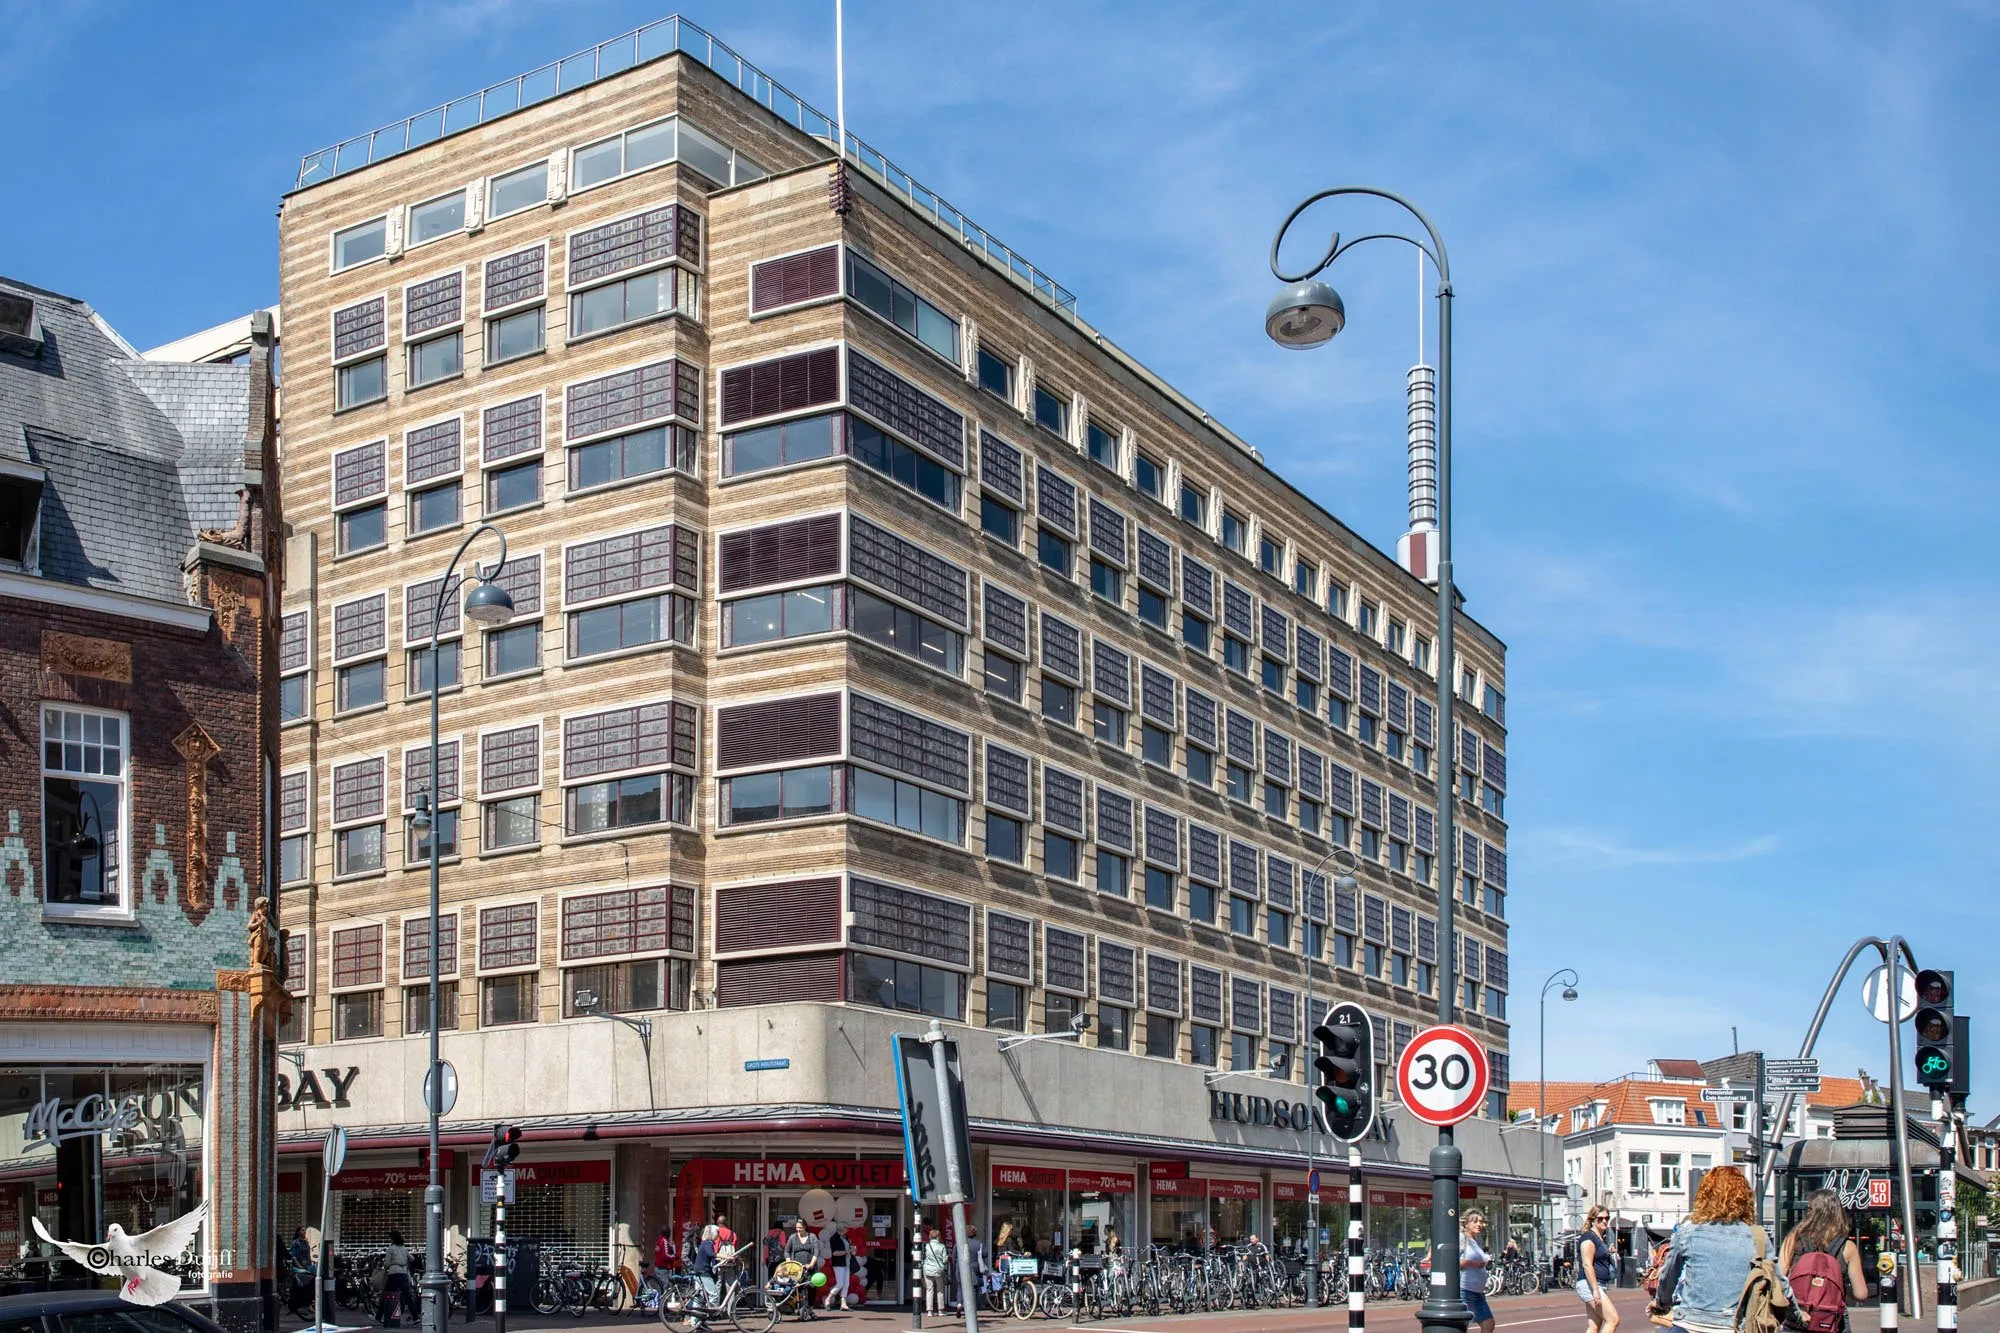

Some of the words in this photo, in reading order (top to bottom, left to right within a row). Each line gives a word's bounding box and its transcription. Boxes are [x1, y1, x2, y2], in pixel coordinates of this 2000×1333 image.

[1339, 1013, 1351, 1024] 2.1
[1412, 1054, 1470, 1090] 30
[278, 1066, 360, 1112] BAY
[1367, 1117, 1395, 1143] AY
[384, 1173, 407, 1184] 70%
[516, 1168, 537, 1181] MA
[734, 1163, 806, 1182] HEMA
[812, 1164, 893, 1183] OUTLET
[1000, 1170, 1027, 1184] HEMA
[1100, 1176, 1116, 1188] 70%
[1156, 1179, 1177, 1191] HEMA
[1872, 1183, 1887, 1193] TO
[1233, 1184, 1246, 1195] 70%
[1277, 1185, 1294, 1197] HEMA
[1872, 1193, 1887, 1204] GO
